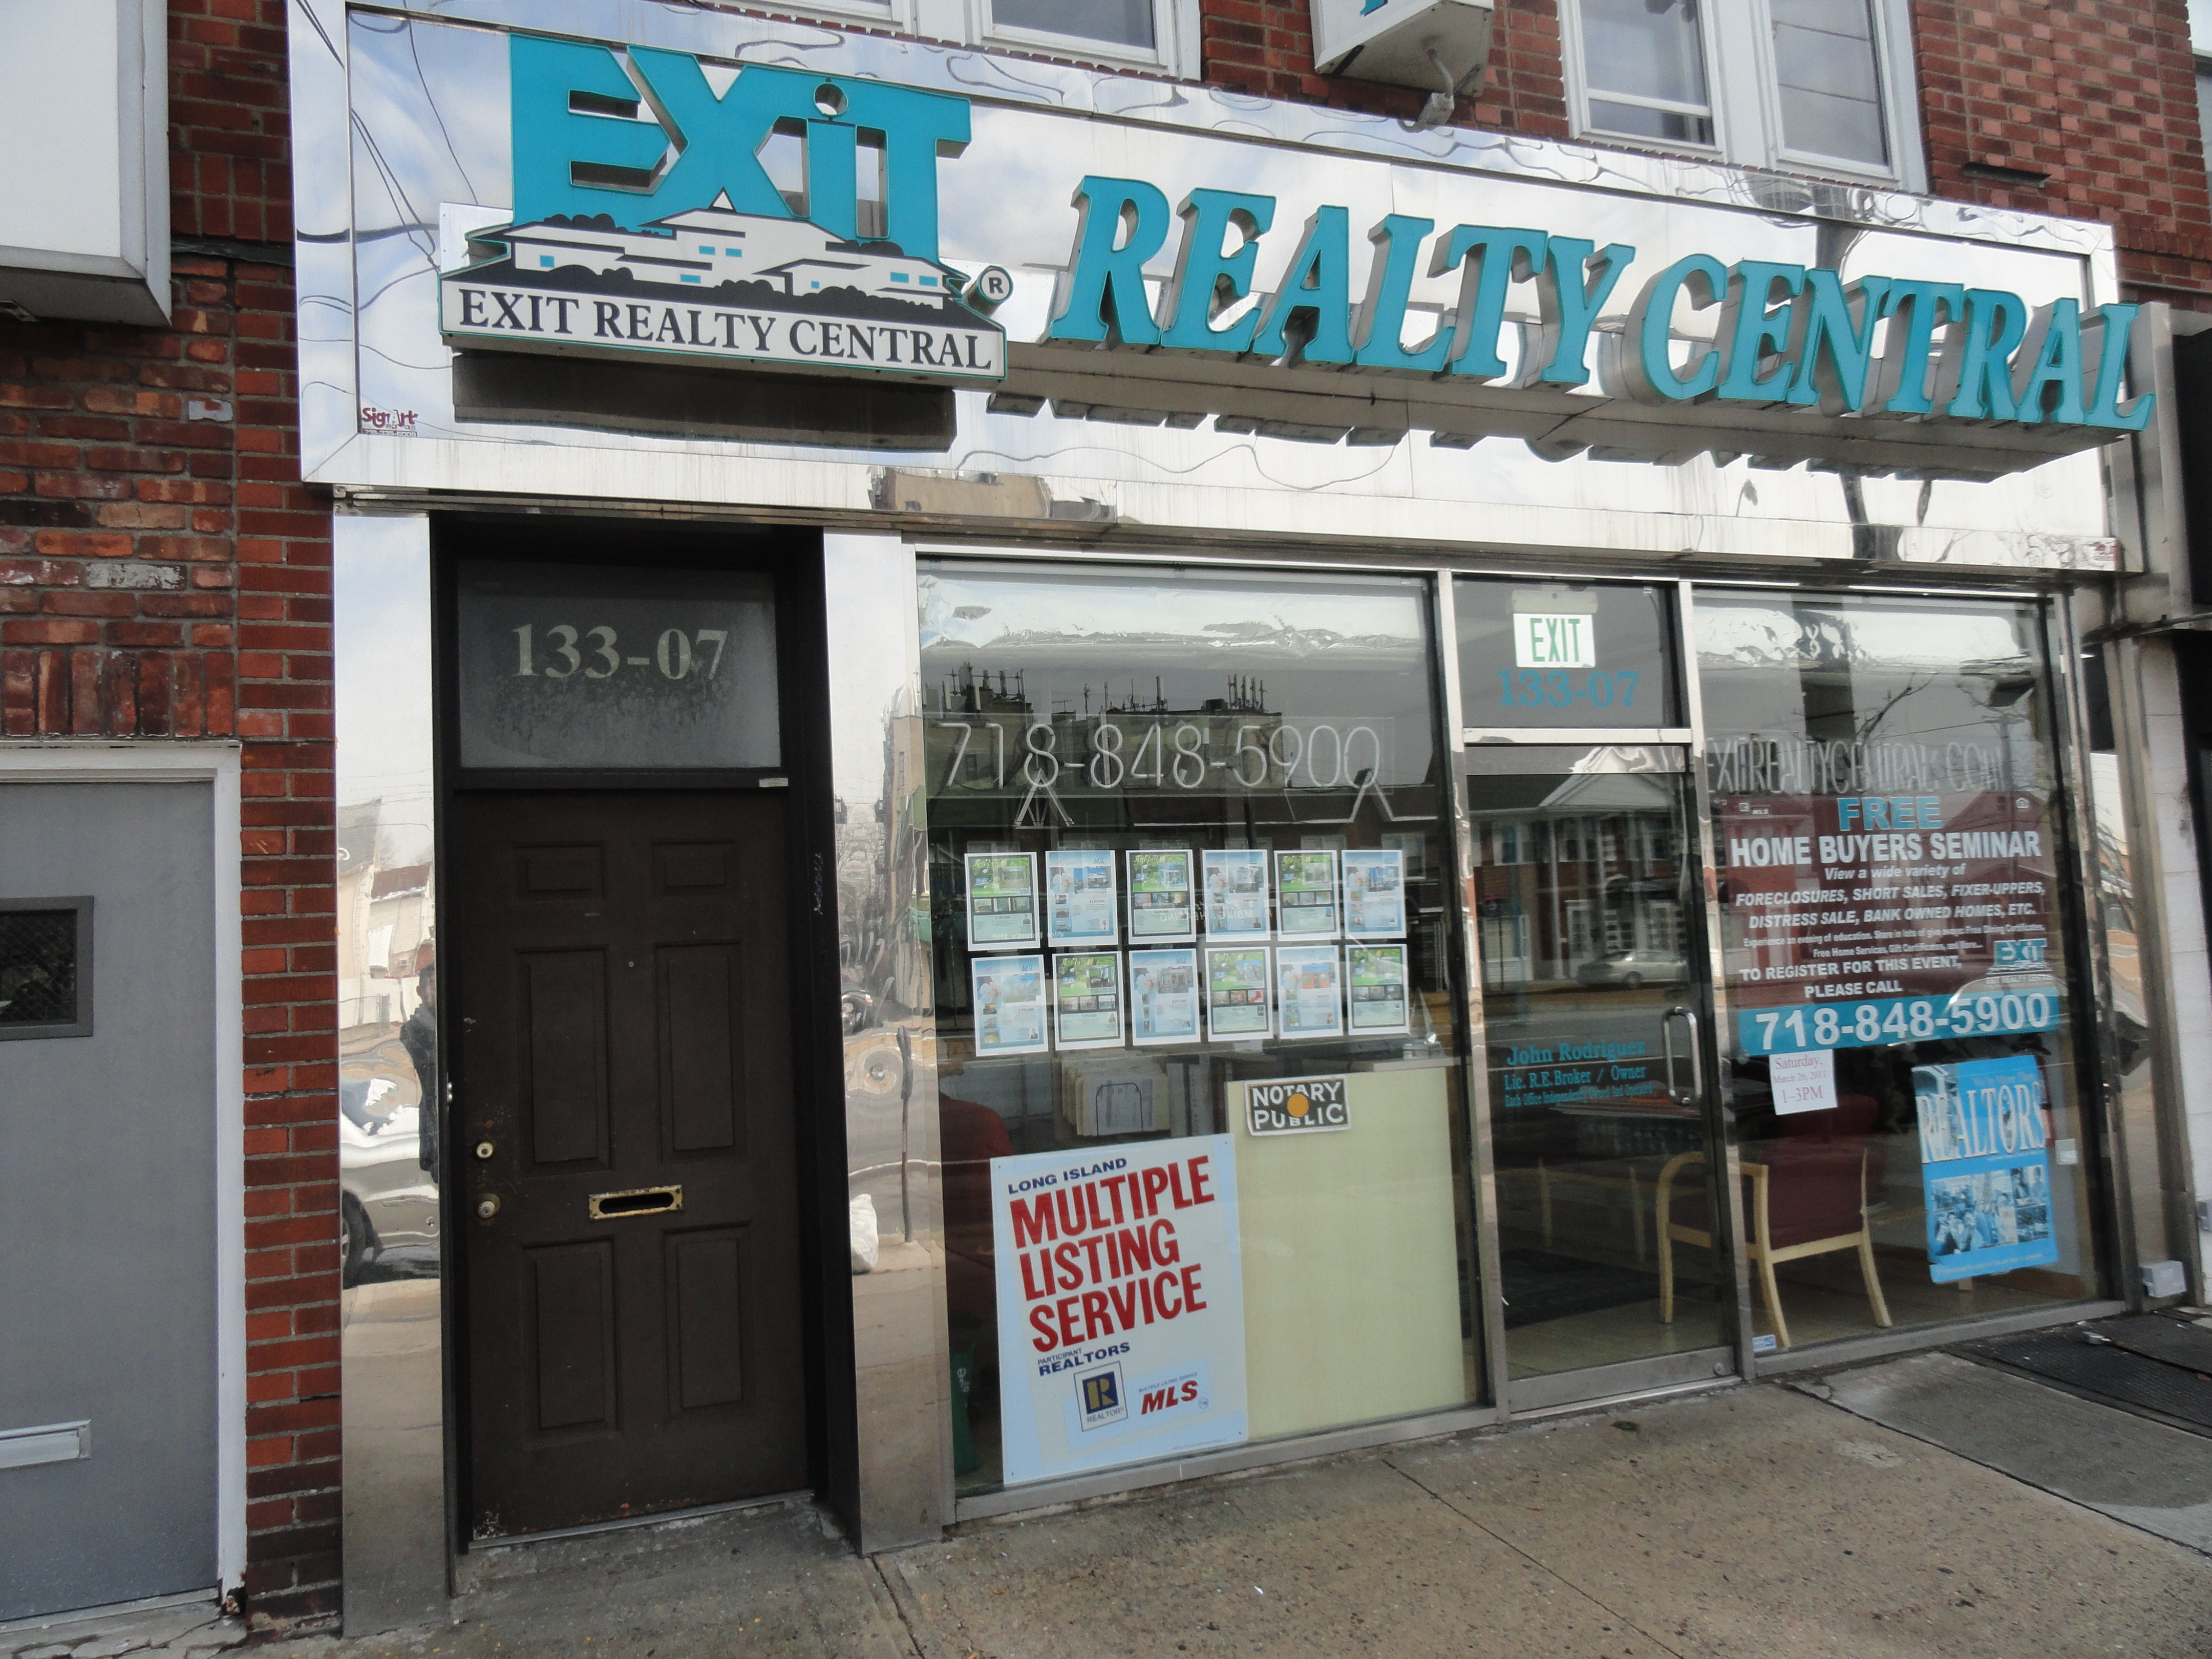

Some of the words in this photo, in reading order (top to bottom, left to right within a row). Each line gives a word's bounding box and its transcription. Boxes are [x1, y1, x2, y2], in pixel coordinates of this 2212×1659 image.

[1050, 175, 1635, 385] REALTY
[1642, 252, 2156, 432] CENTRAL
[459, 288, 579, 335] EXIT
[593, 303, 775, 354] REALTY
[788, 321, 992, 371] CENTRAL
[512, 624, 728, 680] 133-07
[1529, 618, 1580, 663] EXIT
[1497, 669, 1639, 708] 133-07
[935, 722, 1379, 789] 718-848-5900
[1837, 796, 1943, 831] FREE
[1731, 836, 1812, 867] HOME
[1819, 833, 1923, 864] BUYERS
[1929, 831, 2043, 860] SEMINAR
[1824, 867, 1855, 880] View
[1858, 869, 1868, 879] a
[1871, 865, 1902, 878] wide
[1905, 864, 1951, 879] variety
[1951, 863, 1967, 876] of
[1735, 889, 1849, 907] FORECLOSURES,
[1853, 886, 1900, 901] SHORT
[1902, 885, 1948, 900] SALES,
[1951, 881, 2046, 897] FIXER-UPPERS,
[1749, 912, 1818, 929] DISTRESS
[1820, 910, 1860, 926] SALE,
[1864, 908, 1902, 922] BANK
[1904, 906, 1952, 920] OWNED
[1954, 904, 2006, 918] HOMES,
[2008, 902, 2037, 916] ETC.
[1743, 937, 1785, 948] Experience
[1797, 934, 1823, 945] evening
[1824, 933, 1832, 942] of
[1813, 949, 1831, 958] Free
[1832, 947, 1855, 957] Home
[1739, 968, 1761, 981] TO
[1765, 963, 1840, 980] REGISTER
[1842, 961, 1873, 973] FOR
[1875, 958, 1909, 972] THIS
[1911, 955, 1962, 970] EVENT,
[1804, 982, 1863, 998] PLEASE
[1865, 980, 1903, 993] CALL
[1755, 992, 2049, 1050] 718-848-5900
[1506, 1045, 1553, 1066] John
[1558, 1039, 1646, 1062] Rodriguez
[1252, 1081, 1342, 1107] NOTARY
[1504, 1073, 1526, 1090] Lic.
[1554, 1068, 1591, 1085] Broker
[1611, 1065, 1646, 1080] Owner
[1782, 1085, 1824, 1103] 1-3PM
[1254, 1102, 1345, 1130] PUBLIC
[1008, 1174, 1058, 1195] LONG
[1063, 1157, 1128, 1182] ISLAND
[1009, 1155, 1215, 1249] MULTIPLE
[1019, 1219, 1181, 1302] LISTING
[1029, 1263, 1207, 1353] SERVICE
[1037, 1347, 1083, 1365] PARTICIPANT
[1038, 1342, 1131, 1377] REALTORS
[1141, 1380, 1198, 1415] MLS
